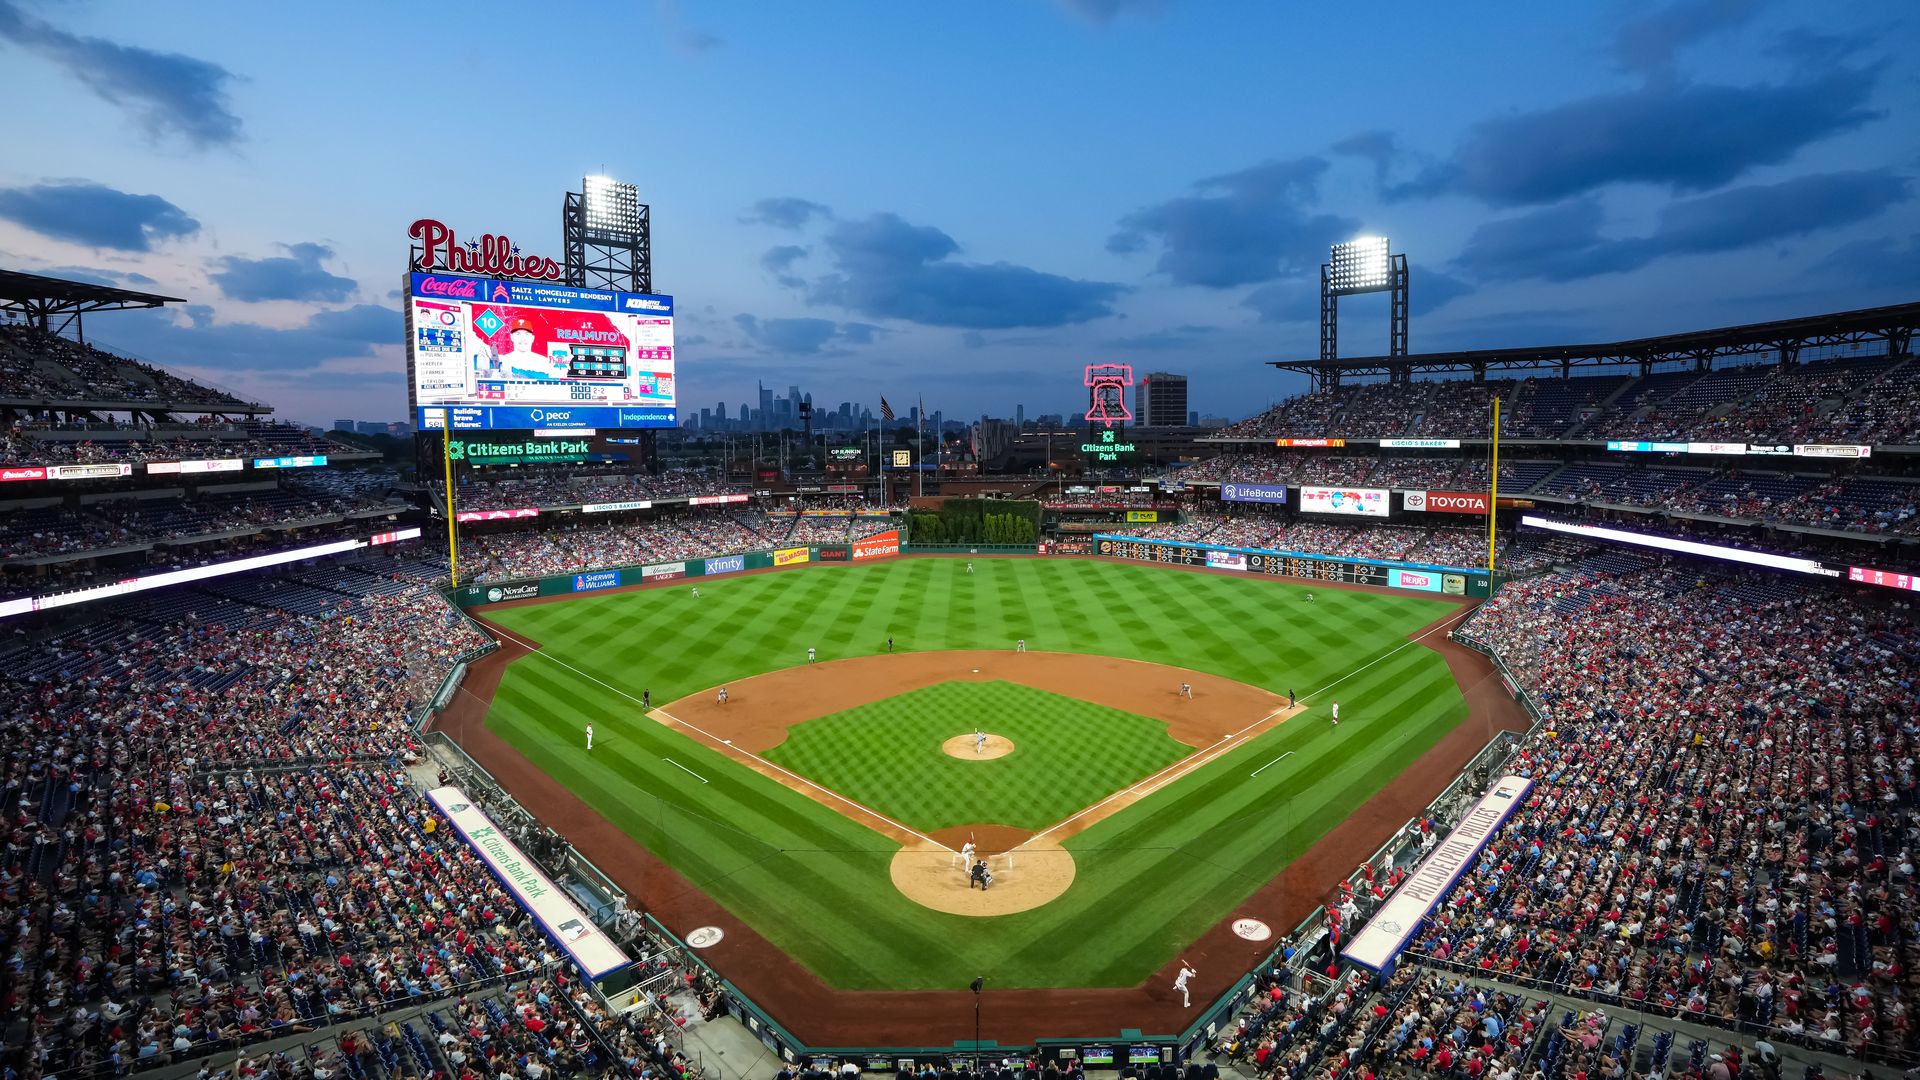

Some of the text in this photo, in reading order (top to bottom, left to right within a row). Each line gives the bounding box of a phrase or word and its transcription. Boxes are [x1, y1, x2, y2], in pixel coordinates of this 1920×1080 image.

[408, 219, 561, 280] Phillies
[420, 277, 478, 298] Coca-Cola
[534, 288, 578, 298] MONGELUZZI
[580, 292, 612, 301] BENDESKY
[481, 318, 496, 328] 10
[556, 329, 618, 342] REALMUTO
[624, 413, 666, 421] Independence
[468, 441, 589, 456] Citizens Bank Park
[1115, 444, 1135, 452] Bank
[1239, 488, 1283, 498] LifeBrand
[1430, 497, 1485, 509] TOYOTA
[708, 558, 741, 573] xfinity
[1402, 576, 1426, 584] HERR'S
[503, 585, 538, 595] NovaCare
[1403, 807, 1500, 902] PHILADELPHIA PHILLIES
[482, 837, 548, 900] Citizens Bank Park
